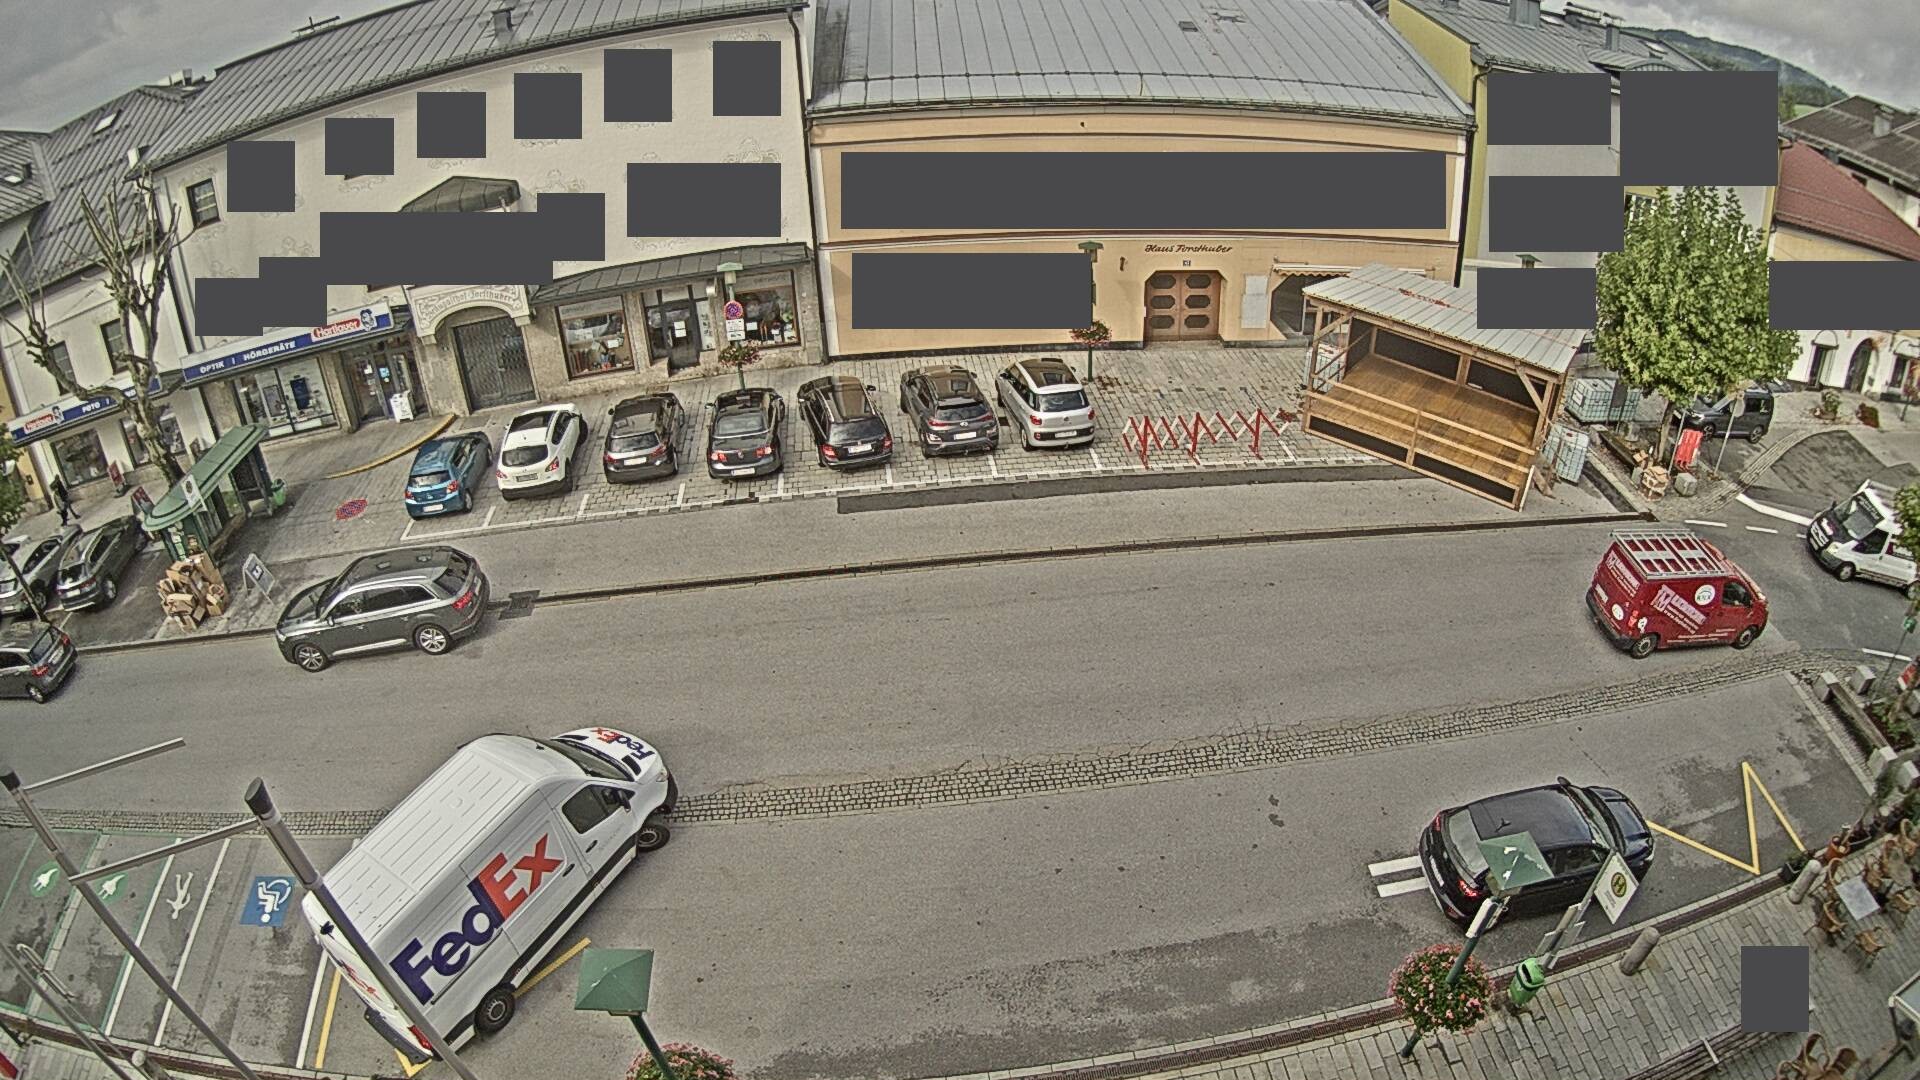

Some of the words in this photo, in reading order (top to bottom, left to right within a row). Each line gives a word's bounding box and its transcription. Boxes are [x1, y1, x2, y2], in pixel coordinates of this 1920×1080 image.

[1145, 244, 1174, 253] Haus
[200, 362, 225, 374] OPTIK
[243, 340, 296, 362] HÖRGERÄTE
[316, 319, 360, 338] Hartlauer
[82, 401, 101, 414] FOTO
[590, 727, 656, 761] FedEx
[389, 833, 564, 1006] FedEx
